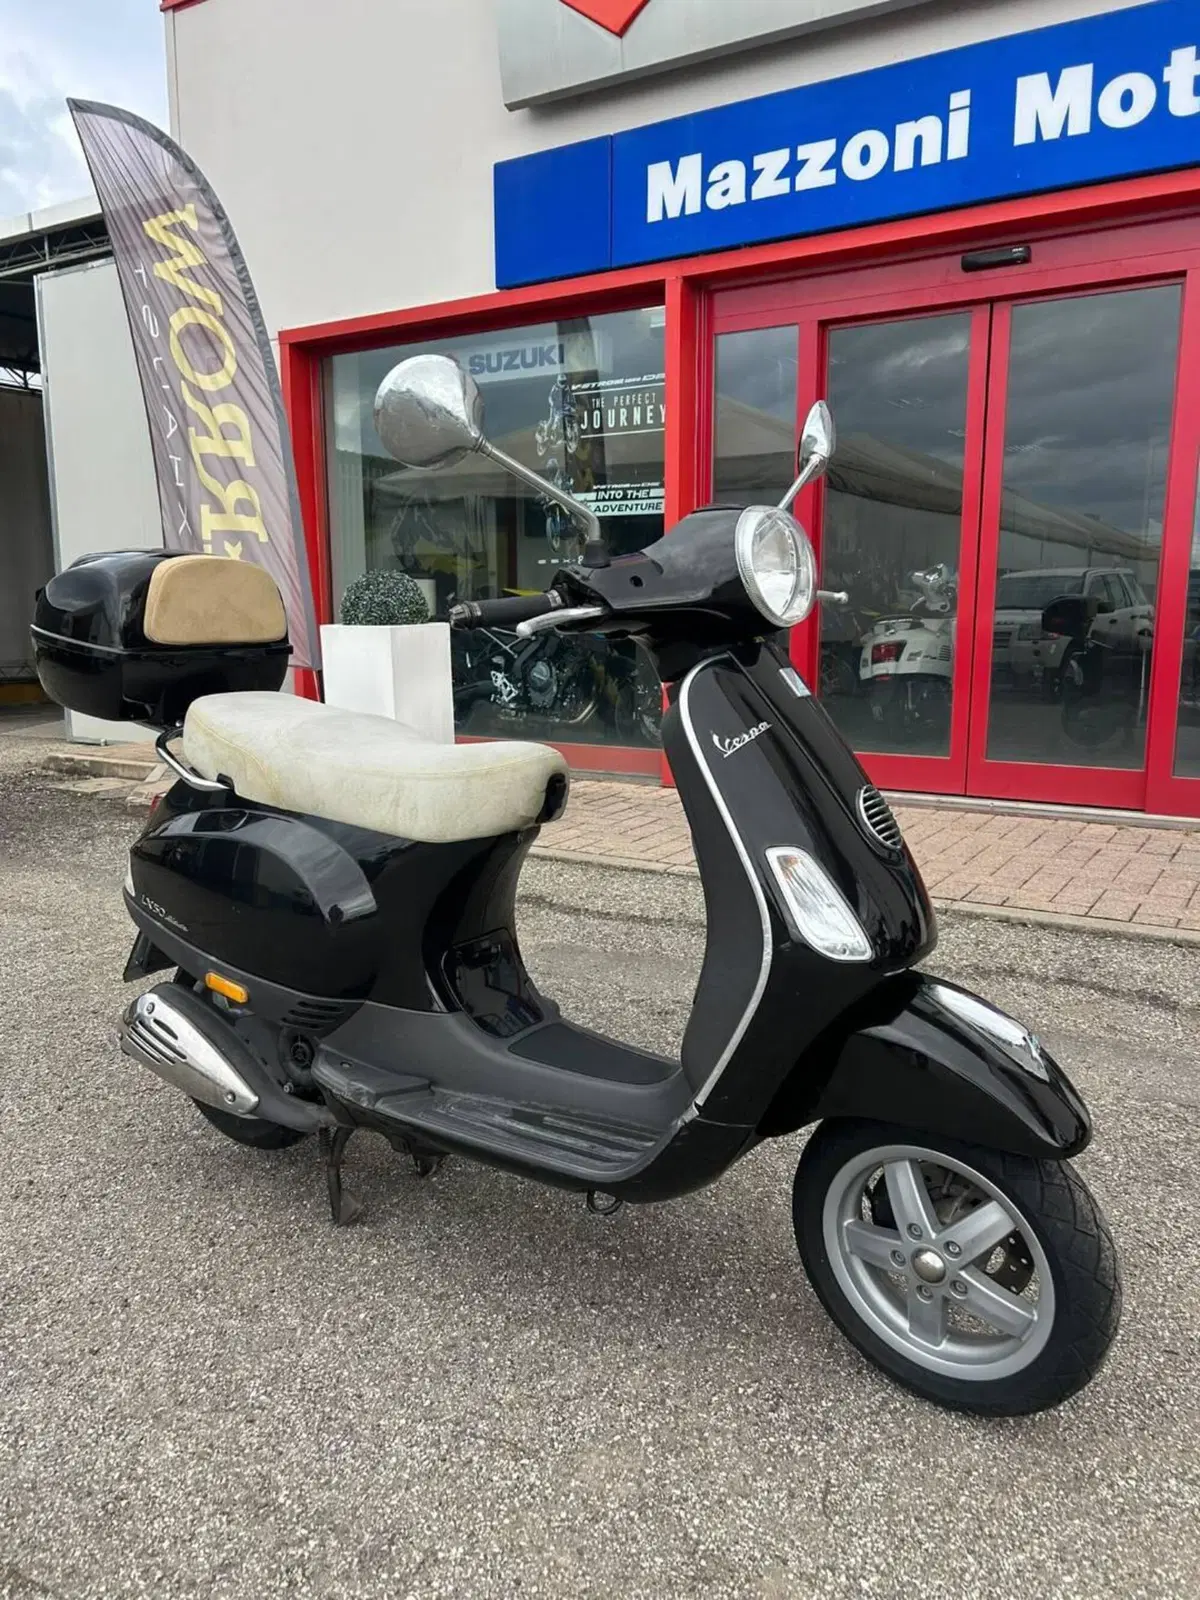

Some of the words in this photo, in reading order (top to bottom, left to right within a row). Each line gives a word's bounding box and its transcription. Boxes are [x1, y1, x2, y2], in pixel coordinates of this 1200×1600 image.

[646, 89, 971, 223] Mazzoni
[1012, 45, 1200, 147] Mot
[469, 344, 564, 375] SUZUKI
[592, 396, 605, 409] THE
[613, 392, 656, 407] PERFECT
[580, 403, 665, 430] JOURNEY
[593, 501, 663, 513] ADVENTURE
[597, 489, 623, 501] INTO
[626, 488, 650, 499] THE
[711, 721, 773, 758] Vespa
